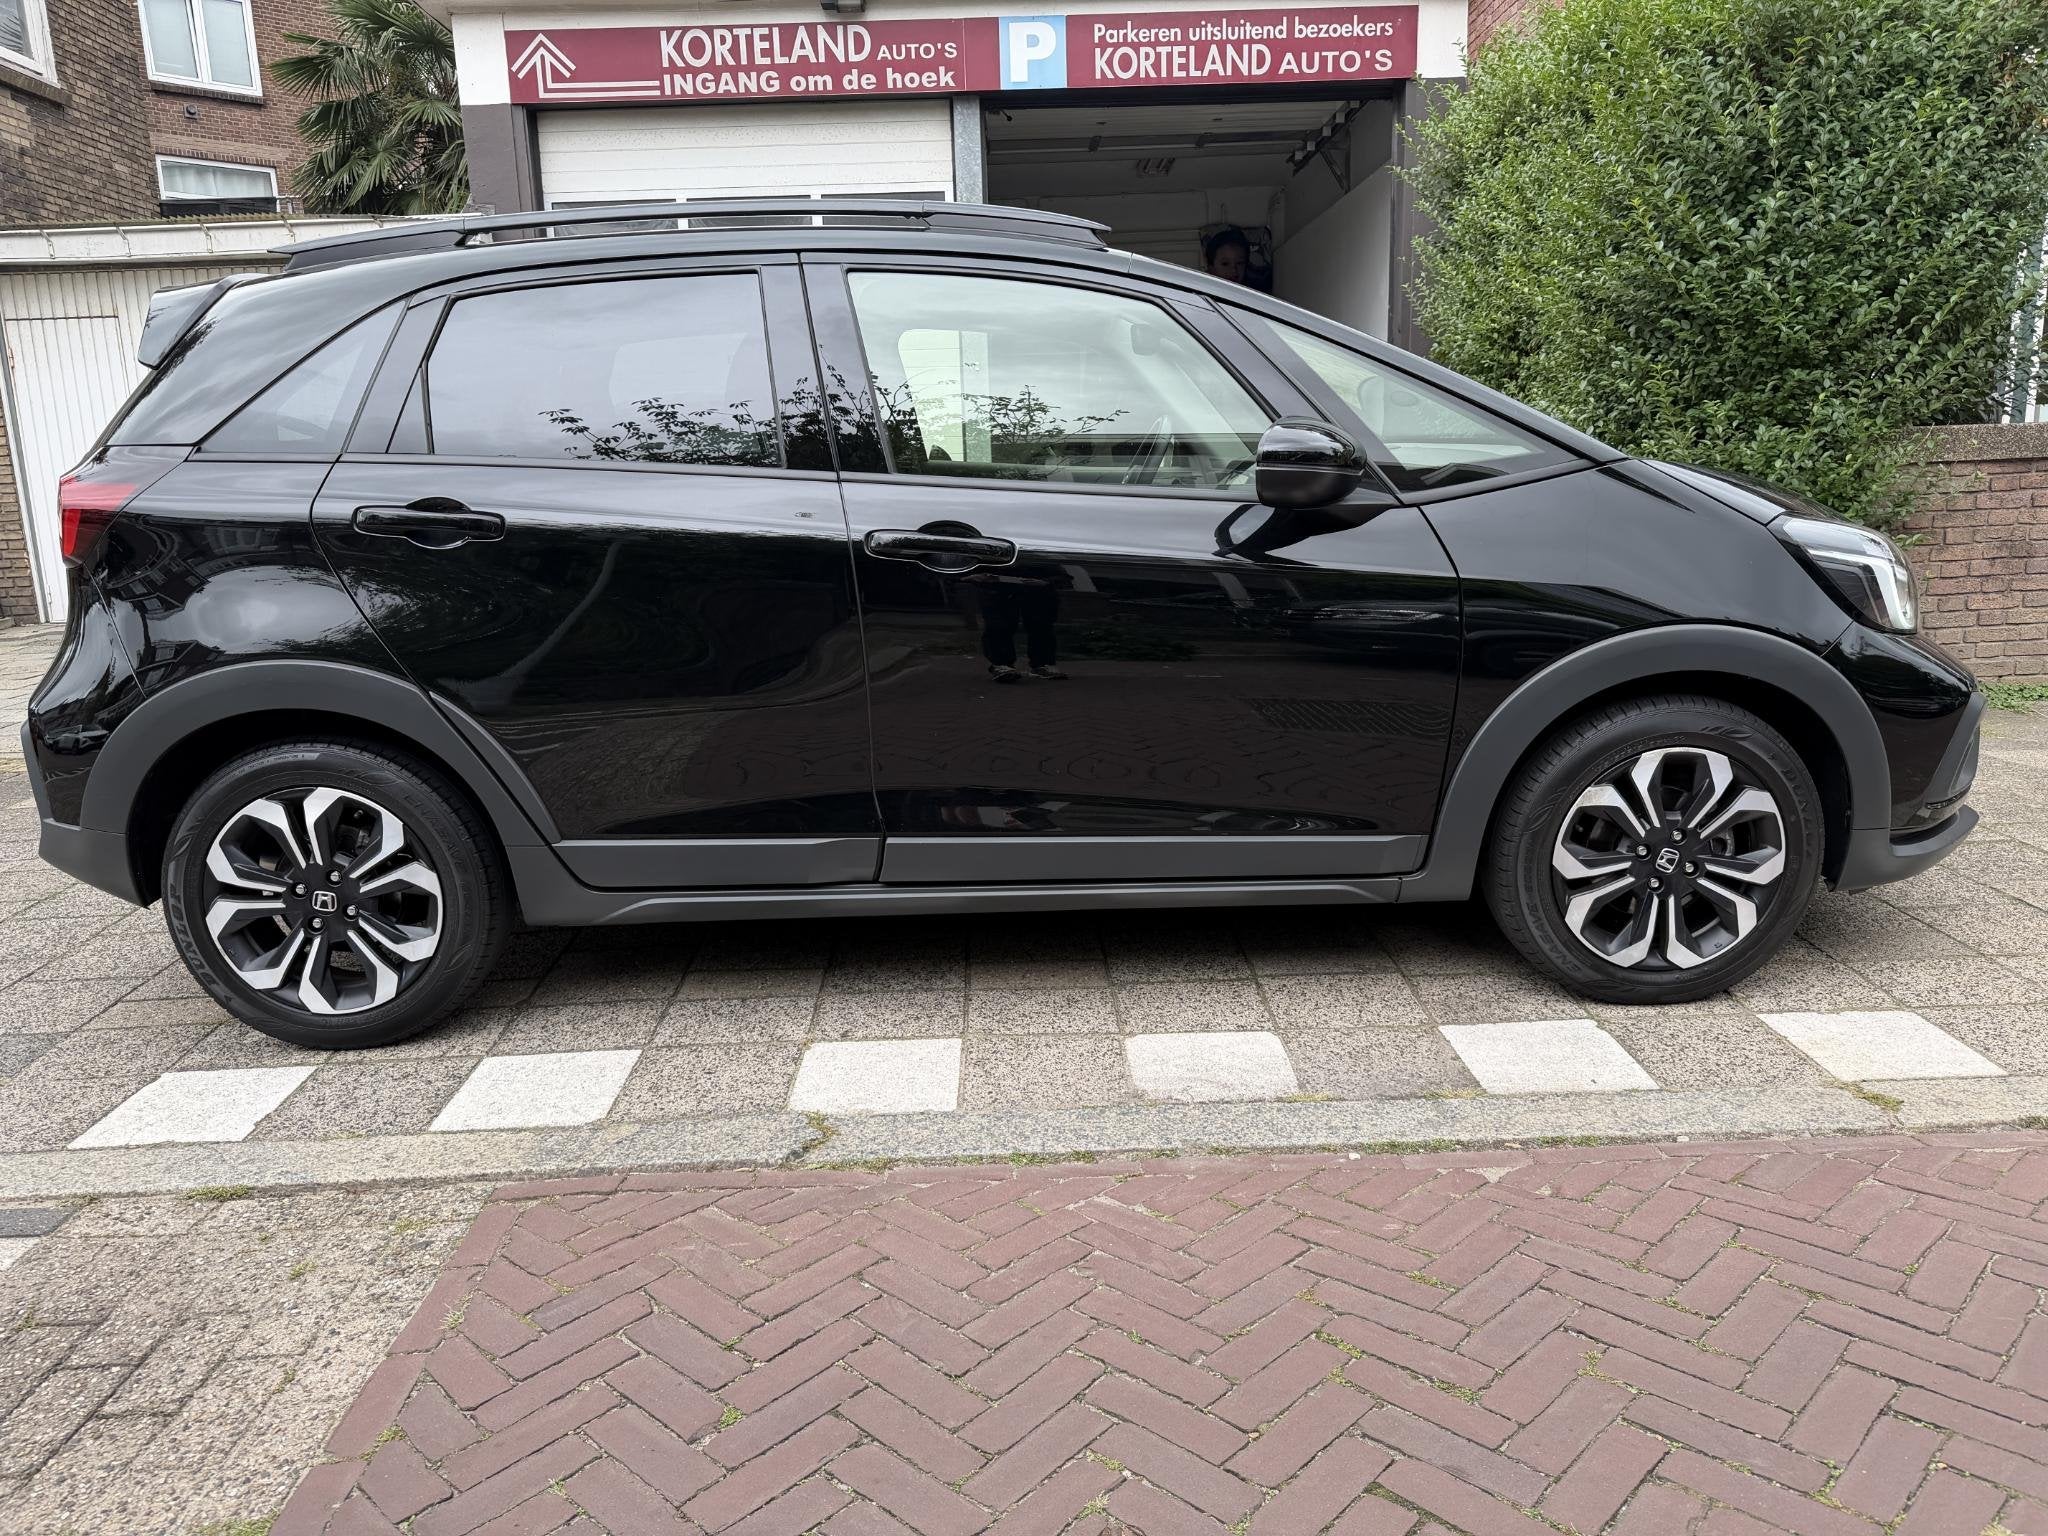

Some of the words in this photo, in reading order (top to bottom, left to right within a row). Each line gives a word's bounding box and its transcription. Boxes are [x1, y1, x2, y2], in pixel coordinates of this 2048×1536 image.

[660, 24, 872, 68] KORTELAND
[876, 42, 959, 61] AUTO'S
[1093, 20, 1182, 44] Parkeren
[1188, 17, 1287, 42] uitsluitend
[1294, 14, 1394, 39] bezoekers
[1008, 21, 1057, 83] P
[1093, 43, 1273, 81] KORTELAND
[1278, 49, 1394, 75] AUTO'S
[663, 70, 781, 96] INGANG
[790, 74, 834, 92] om
[842, 68, 878, 91] de
[886, 66, 957, 89] hoek
